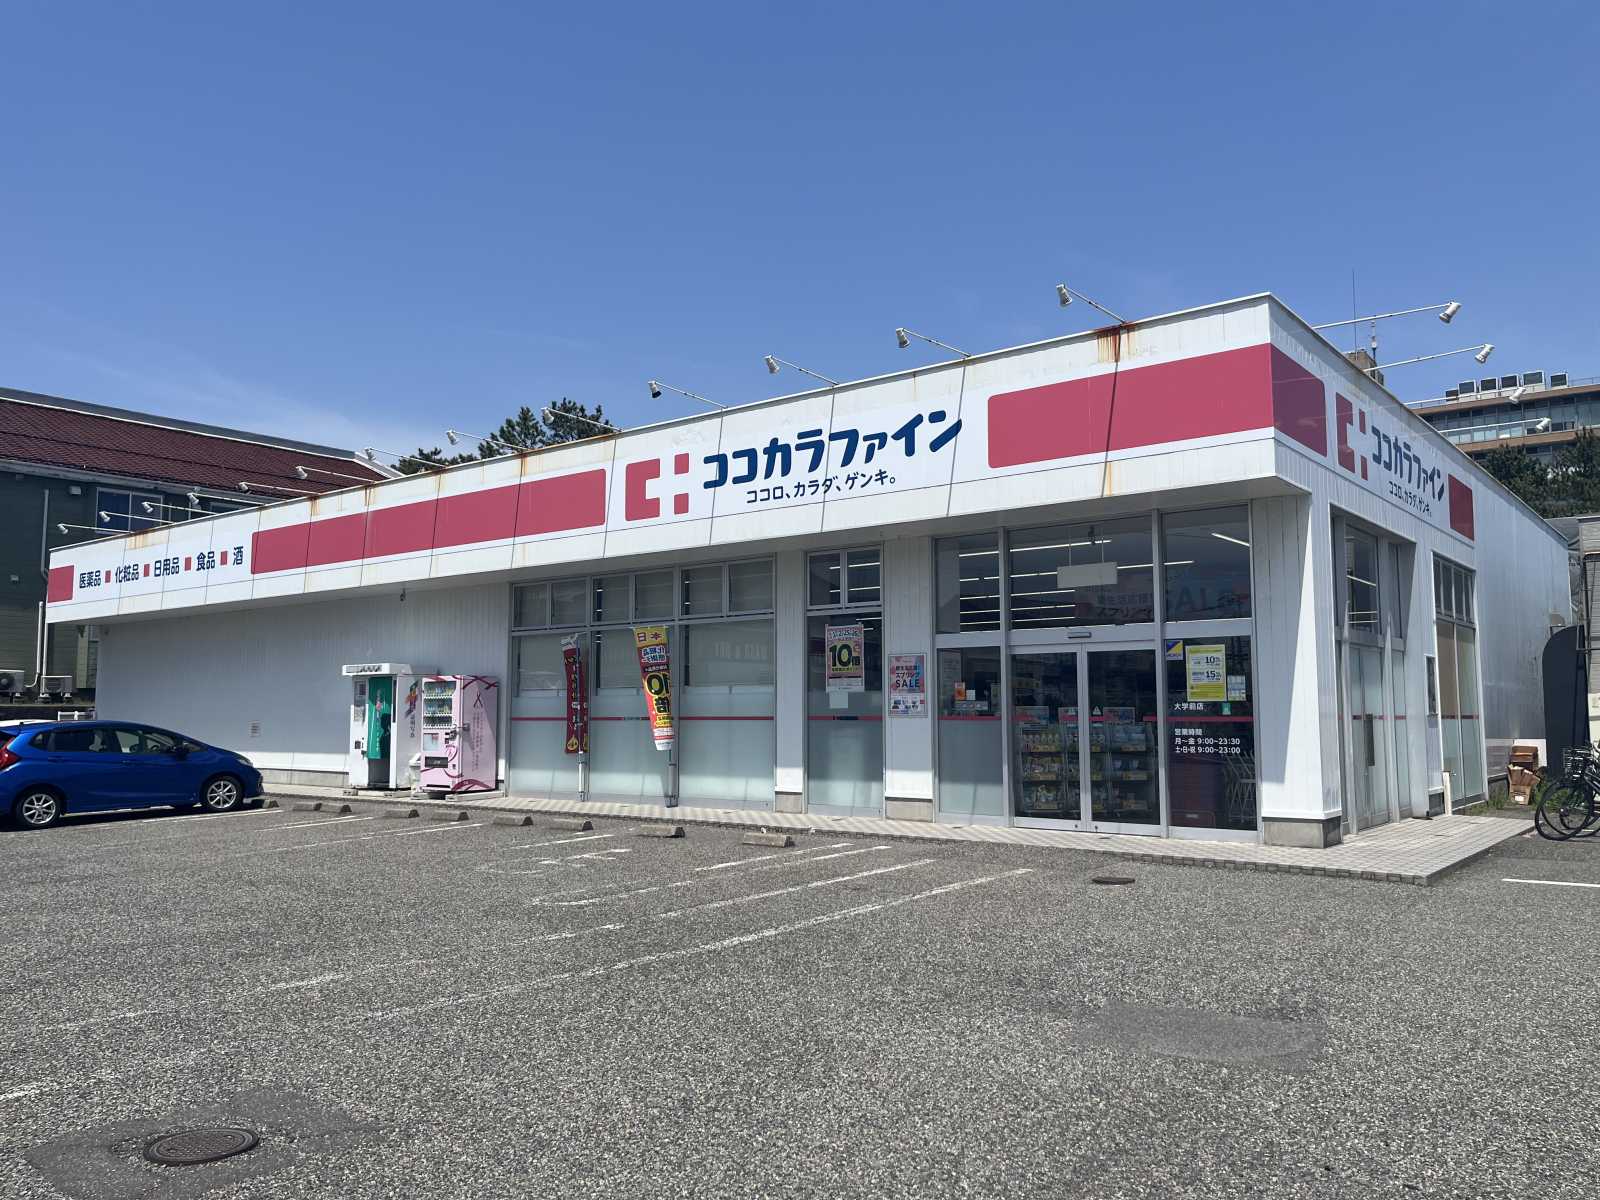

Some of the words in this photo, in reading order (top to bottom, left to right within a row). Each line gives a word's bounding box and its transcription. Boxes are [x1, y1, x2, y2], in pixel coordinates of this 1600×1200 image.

[703, 409, 963, 490] ココカラファイン
[1371, 425, 1445, 502] ココカラファイン
[746, 468, 896, 504] ココロ、カラダ、ゲンキ。
[1388, 480, 1432, 517] ココロ、カラダ、ゲンキ。
[79, 569, 101, 590] 医薬品
[114, 563, 139, 584] 化粧品
[154, 557, 180, 577] 日用品
[195, 551, 215, 572] 食品
[232, 545, 244, 566] 酒
[895, 679, 920, 688] SALE
[1174, 702, 1204, 711] 大学前店
[1174, 728, 1203, 736] 営業時間
